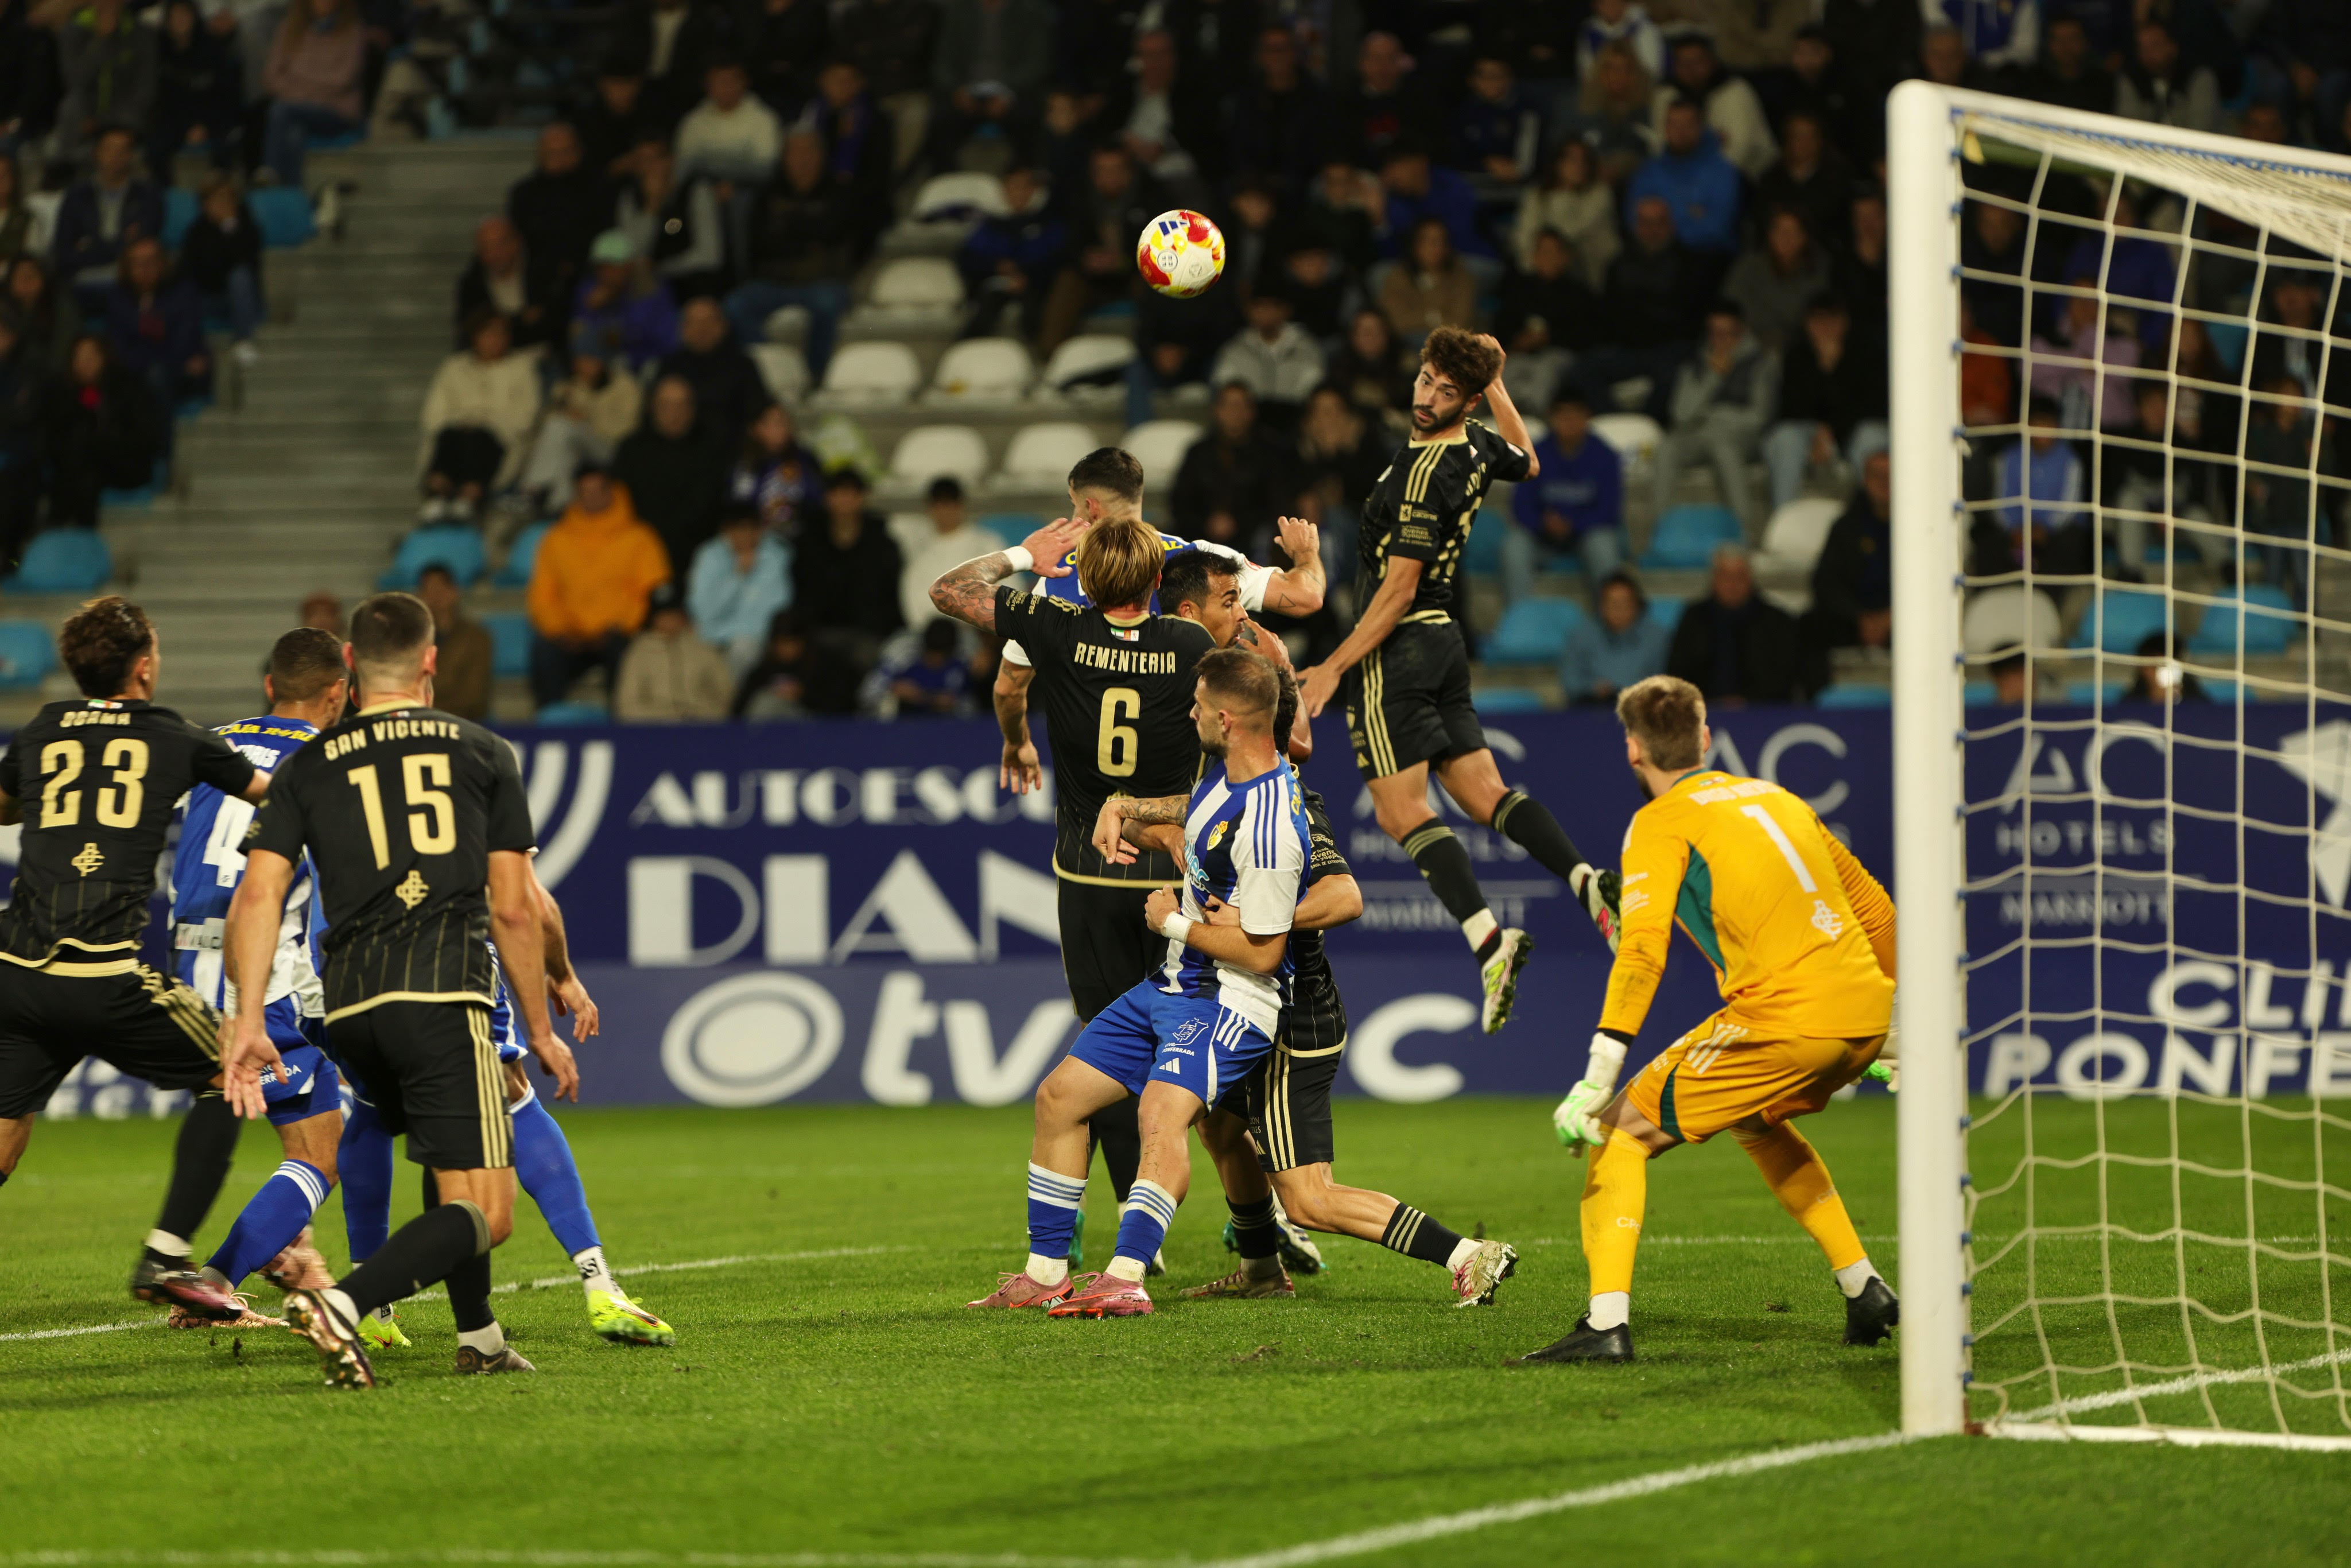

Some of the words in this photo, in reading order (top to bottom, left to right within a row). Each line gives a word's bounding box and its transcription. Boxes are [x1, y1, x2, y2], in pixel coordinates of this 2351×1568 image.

[1074, 642, 1176, 674] REMENTERIA
[324, 728, 367, 761] SAN
[372, 720, 460, 742] VICENTE
[1097, 687, 1140, 777] 6
[39, 738, 149, 828] 23
[347, 753, 457, 871] 15
[202, 794, 256, 888] 4
[1739, 804, 1818, 893] 1
[1995, 820, 2175, 856] HOTELS
